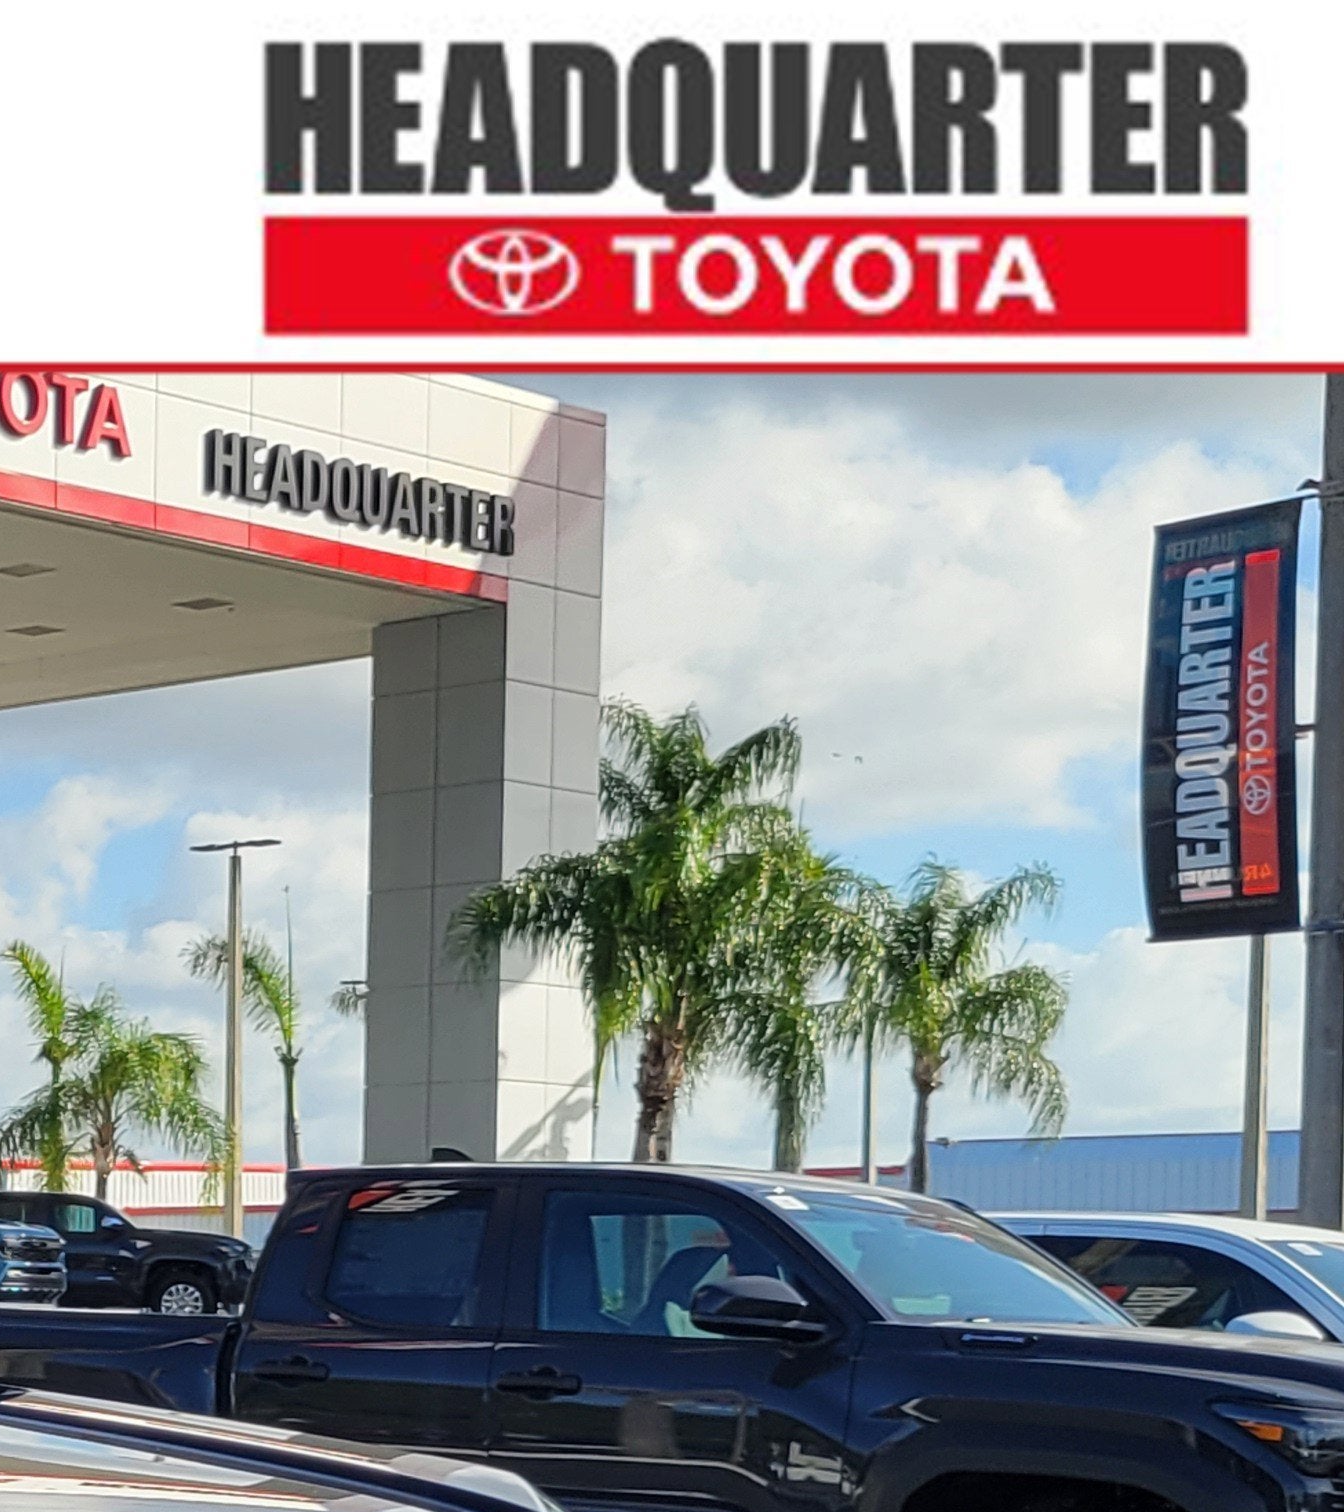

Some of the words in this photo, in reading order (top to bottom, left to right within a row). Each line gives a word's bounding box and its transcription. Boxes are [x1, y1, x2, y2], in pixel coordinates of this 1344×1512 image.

[201, 427, 514, 557] HEADQUARTER
[1174, 559, 1237, 903] HEADQUARTER
[1245, 641, 1269, 771] TOYOTA
